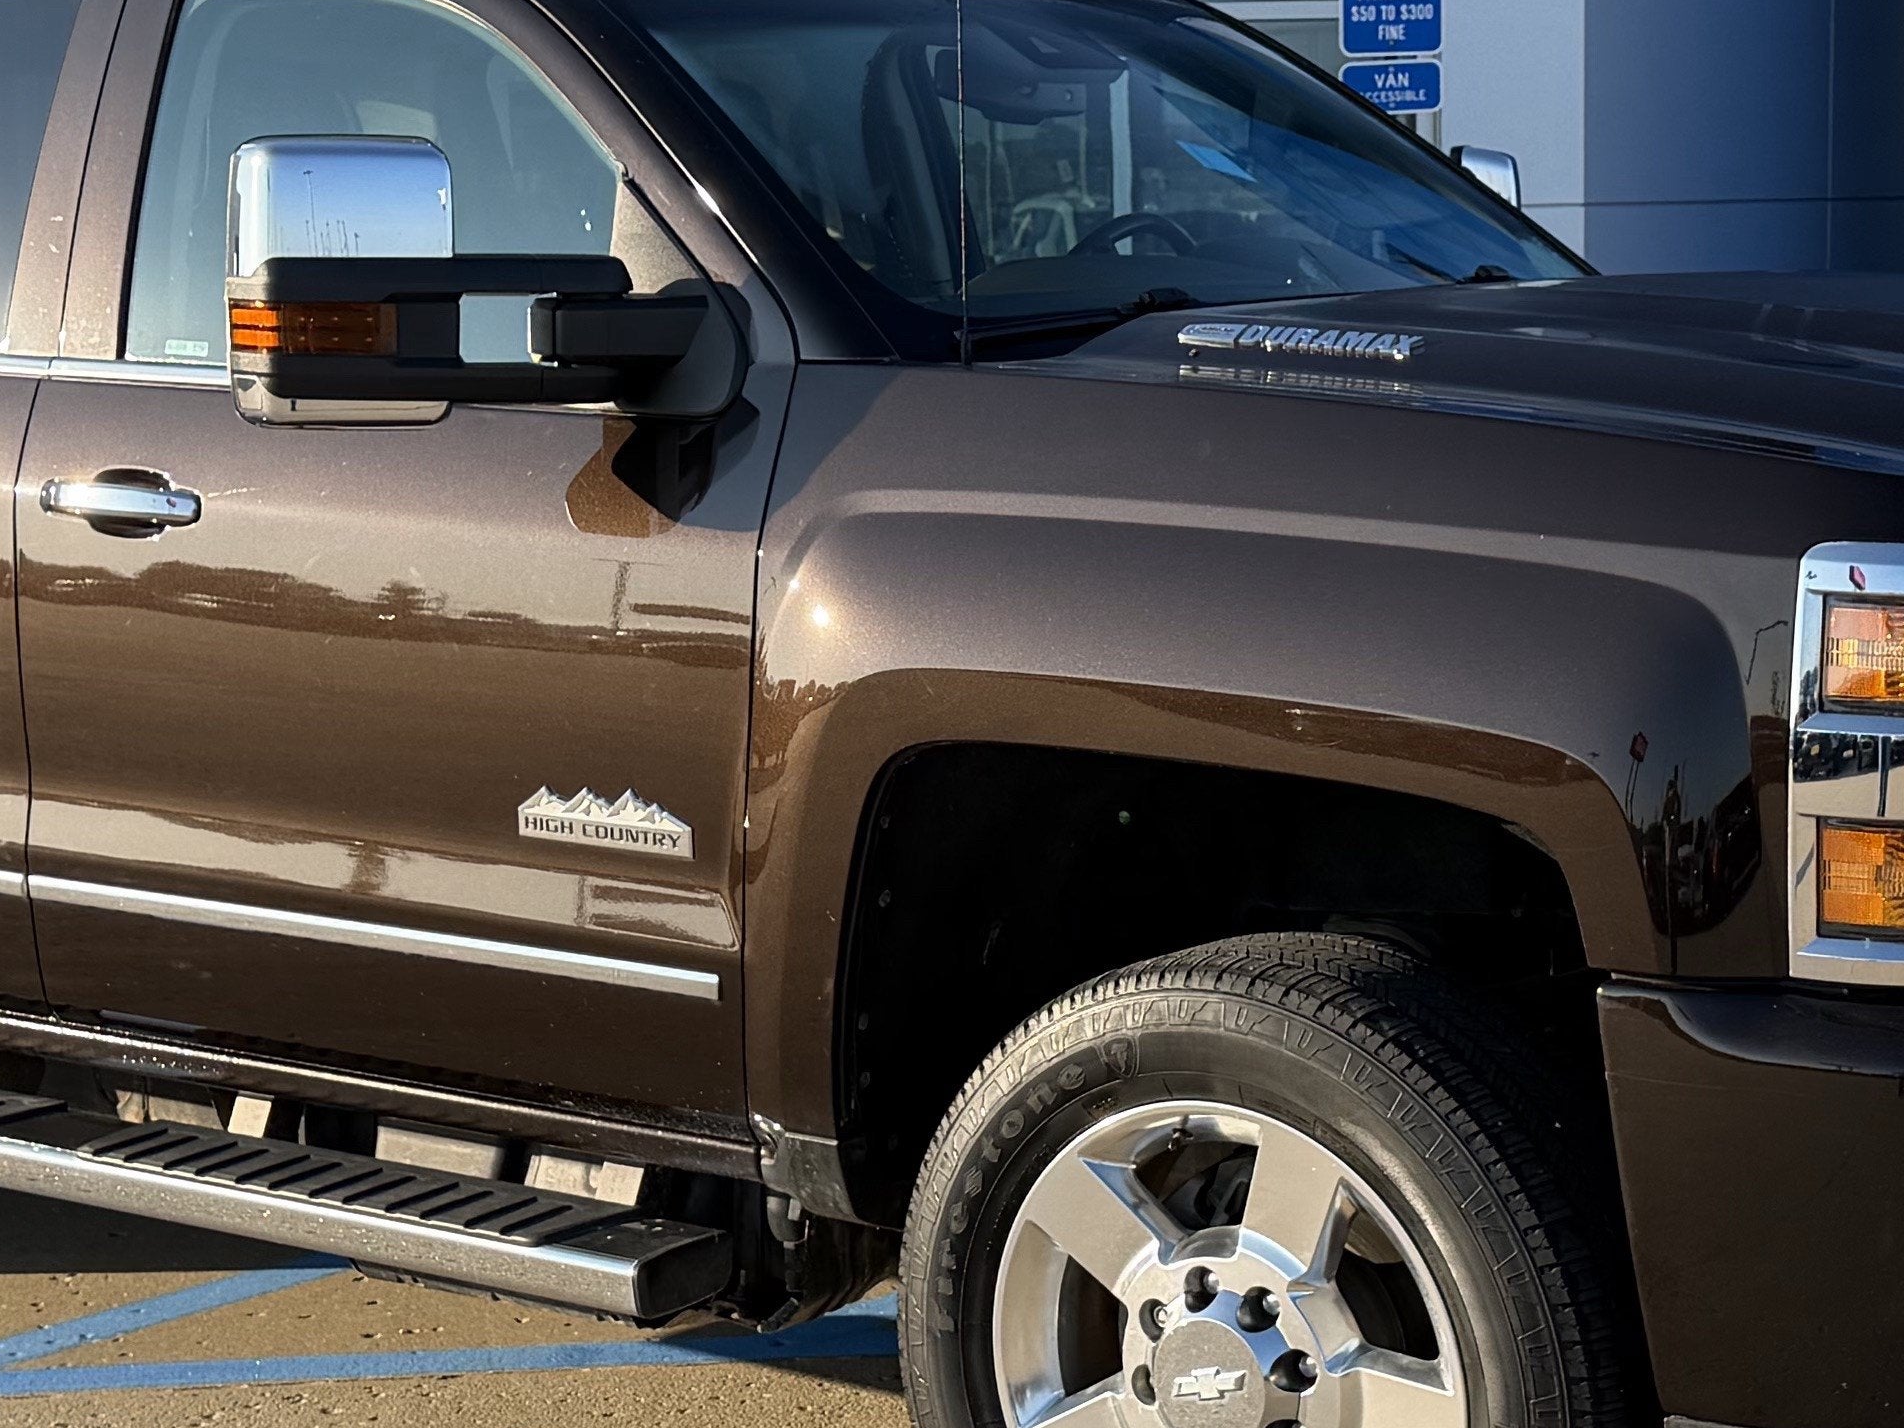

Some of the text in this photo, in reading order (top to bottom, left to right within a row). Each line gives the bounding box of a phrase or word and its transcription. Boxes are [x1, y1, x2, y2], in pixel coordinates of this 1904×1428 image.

[1351, 3, 1434, 22] $50 TO $300
[1378, 24, 1407, 41] FINE
[1374, 72, 1410, 89] VAN
[1239, 324, 1424, 360] DURAMAX
[524, 815, 681, 850] HIGH COUNTRY
